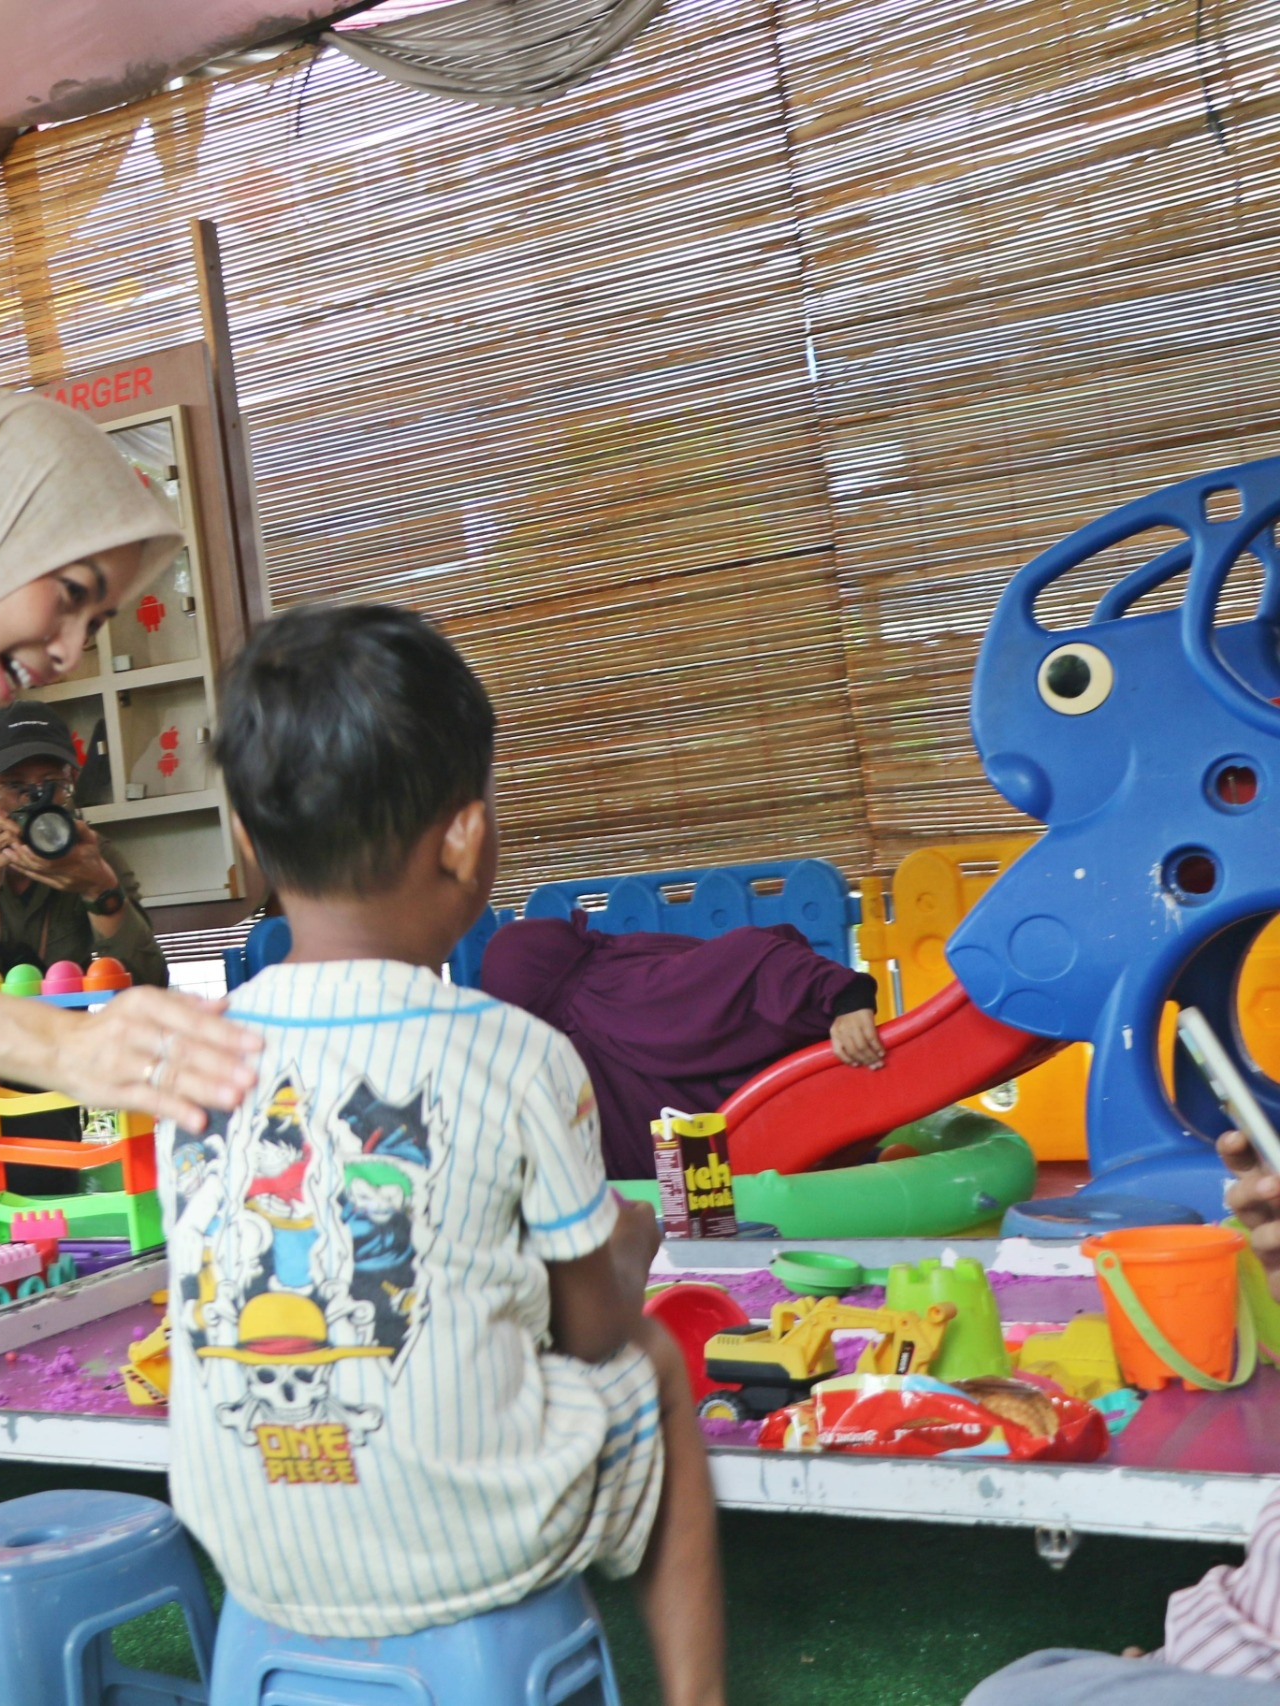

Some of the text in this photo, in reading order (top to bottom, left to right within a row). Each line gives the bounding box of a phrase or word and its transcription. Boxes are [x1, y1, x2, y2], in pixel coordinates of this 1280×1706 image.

[44, 366, 153, 411] ARGER
[685, 1152, 732, 1191] teh
[256, 1424, 352, 1460] ONE
[267, 1459, 358, 1484] PIECE
